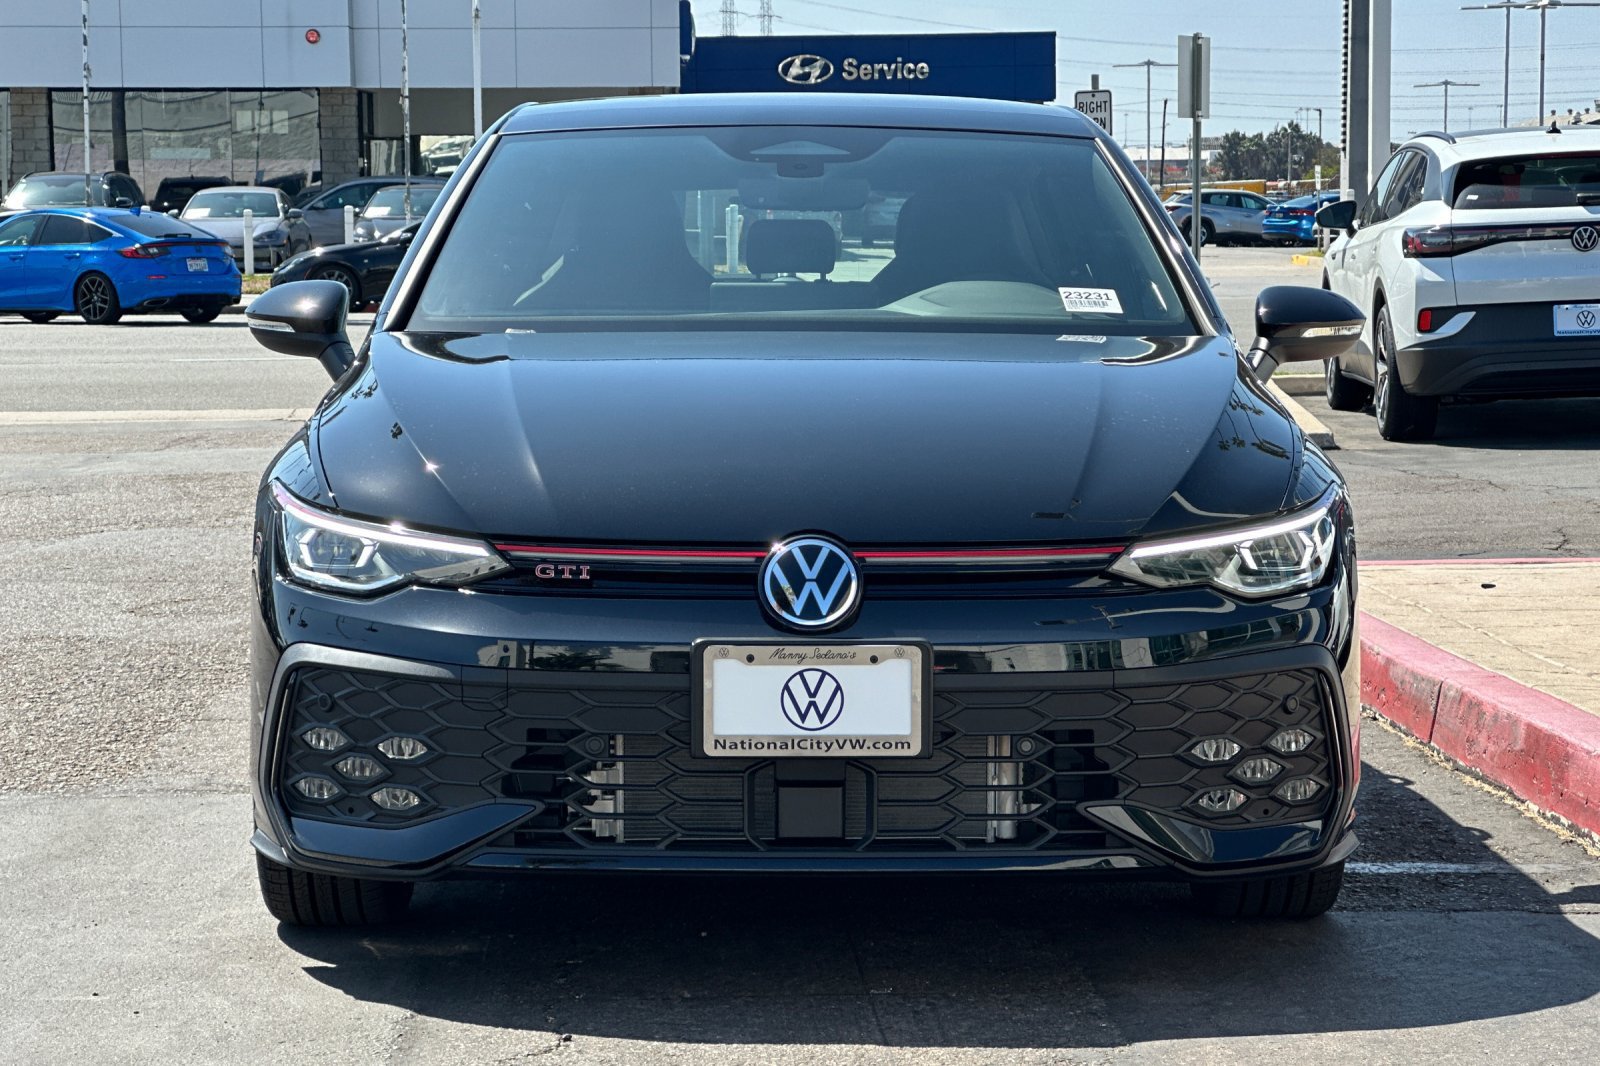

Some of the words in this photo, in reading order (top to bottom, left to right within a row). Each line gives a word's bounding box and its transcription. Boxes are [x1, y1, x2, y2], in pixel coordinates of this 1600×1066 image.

[842, 57, 929, 81] Service
[1078, 100, 1108, 114] RIGHT
[1063, 291, 1112, 301] 23231
[535, 564, 590, 579] GTI
[769, 543, 853, 619] VW
[769, 648, 808, 664] Manny
[782, 670, 843, 727] VW
[713, 738, 911, 752] NationalCityVW.com
